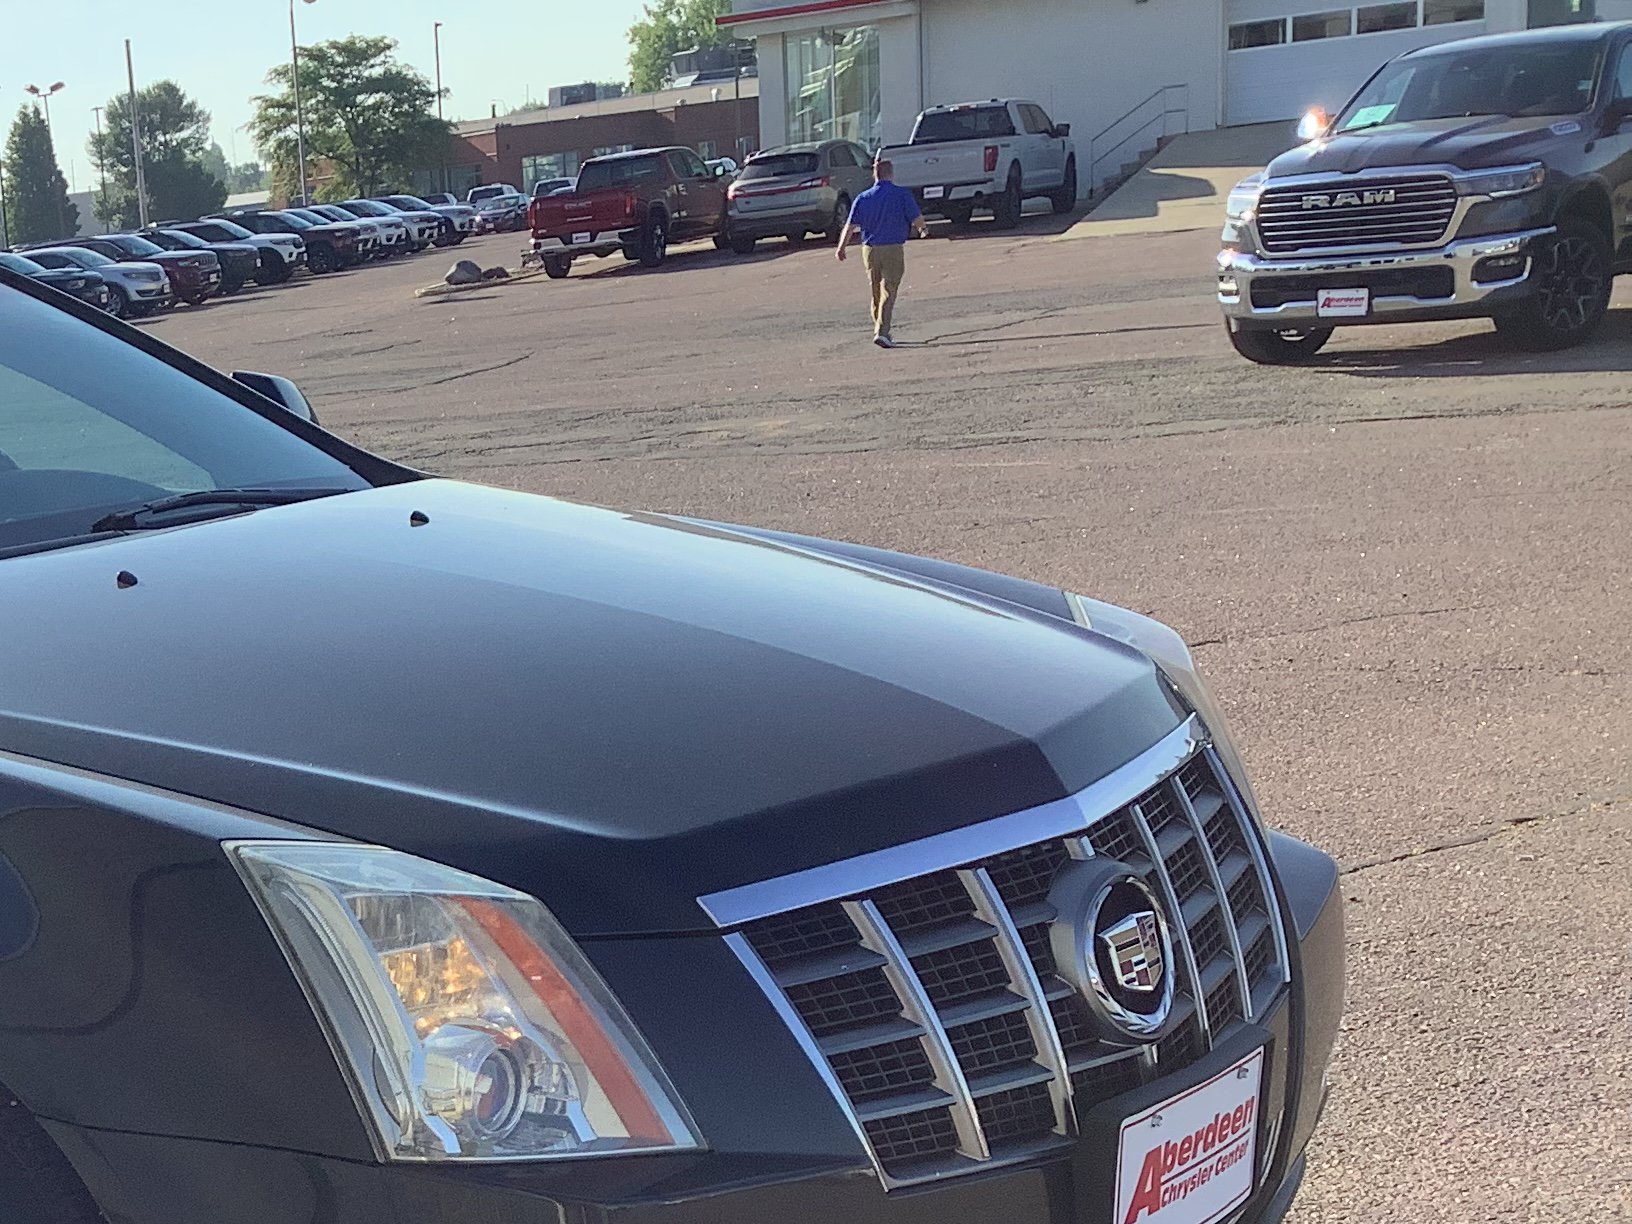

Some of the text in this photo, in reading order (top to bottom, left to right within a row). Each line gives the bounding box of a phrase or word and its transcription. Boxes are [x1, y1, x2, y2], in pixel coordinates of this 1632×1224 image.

[1301, 189, 1396, 210] RAM
[1160, 1139, 1249, 1208] Chrysler Center
